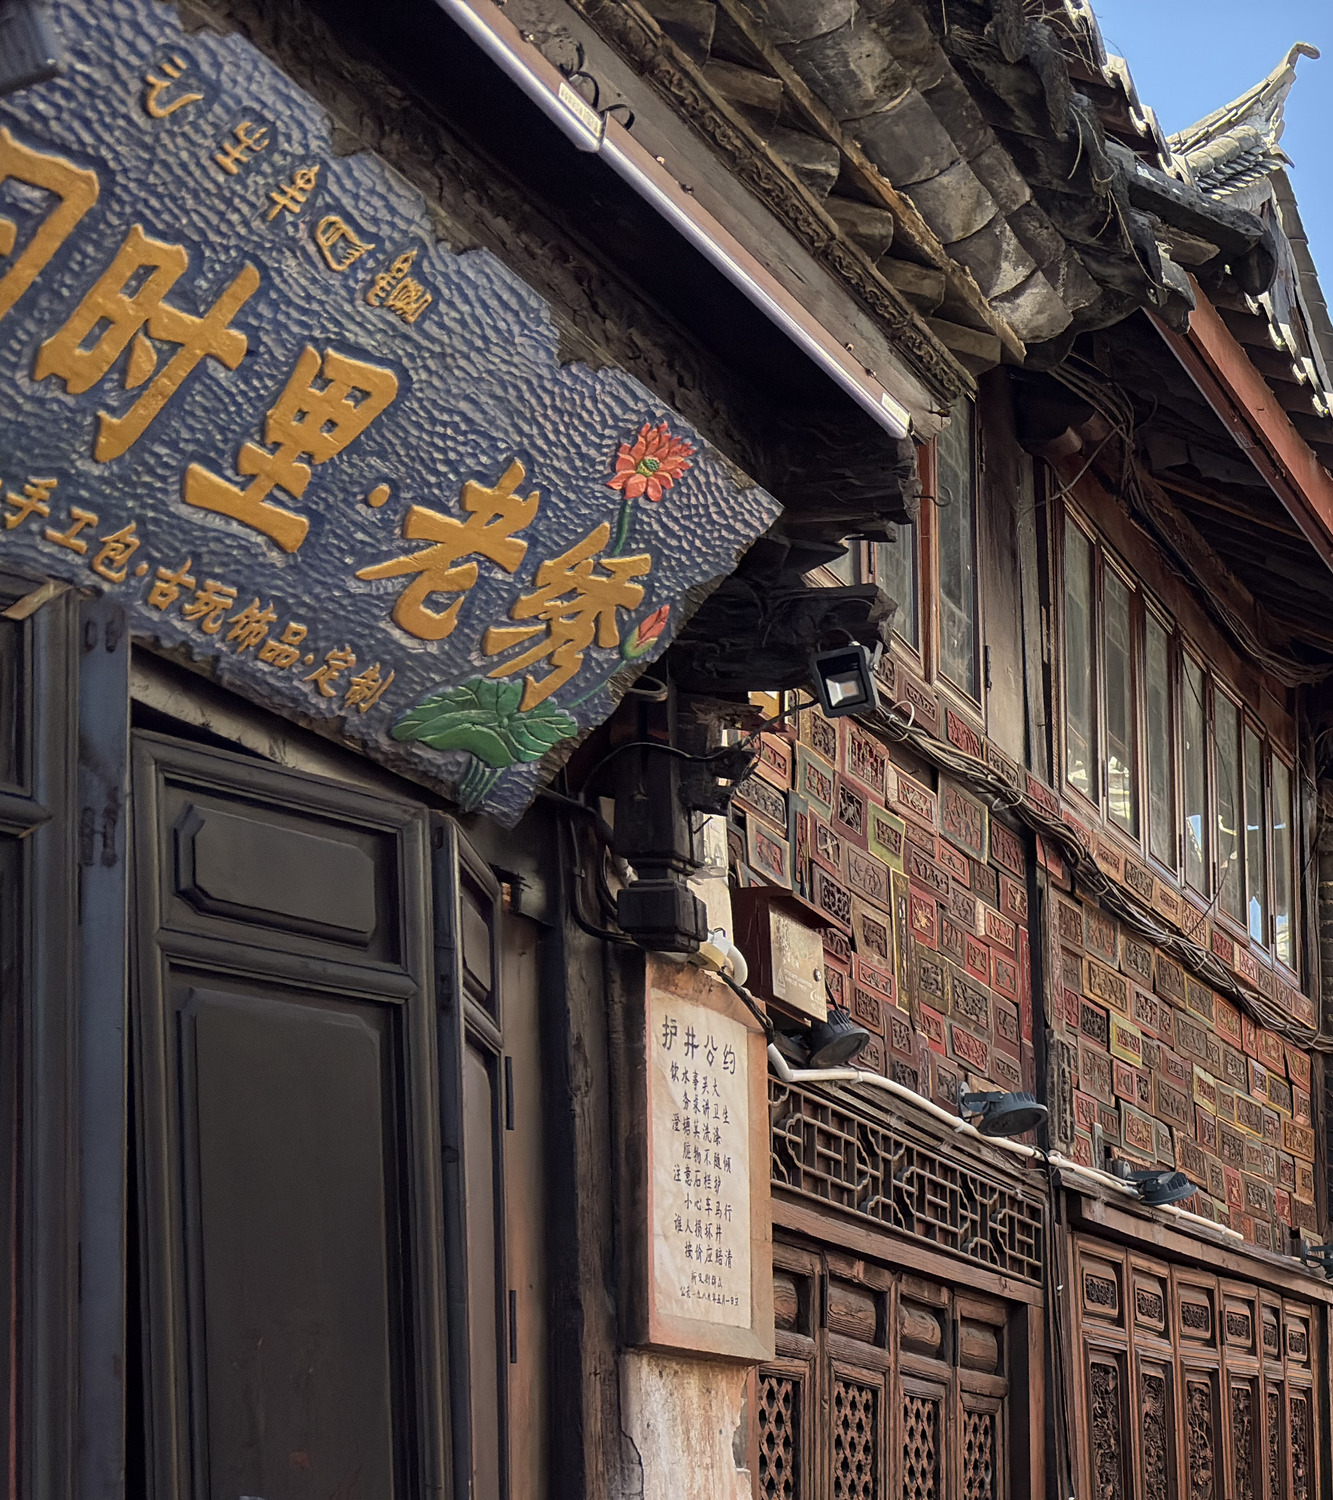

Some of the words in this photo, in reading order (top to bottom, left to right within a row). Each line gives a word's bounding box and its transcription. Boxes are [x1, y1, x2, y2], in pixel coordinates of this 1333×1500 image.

[661, 1013, 736, 1075] 护井公约
[684, 1192, 732, 1223] 小心车马行
